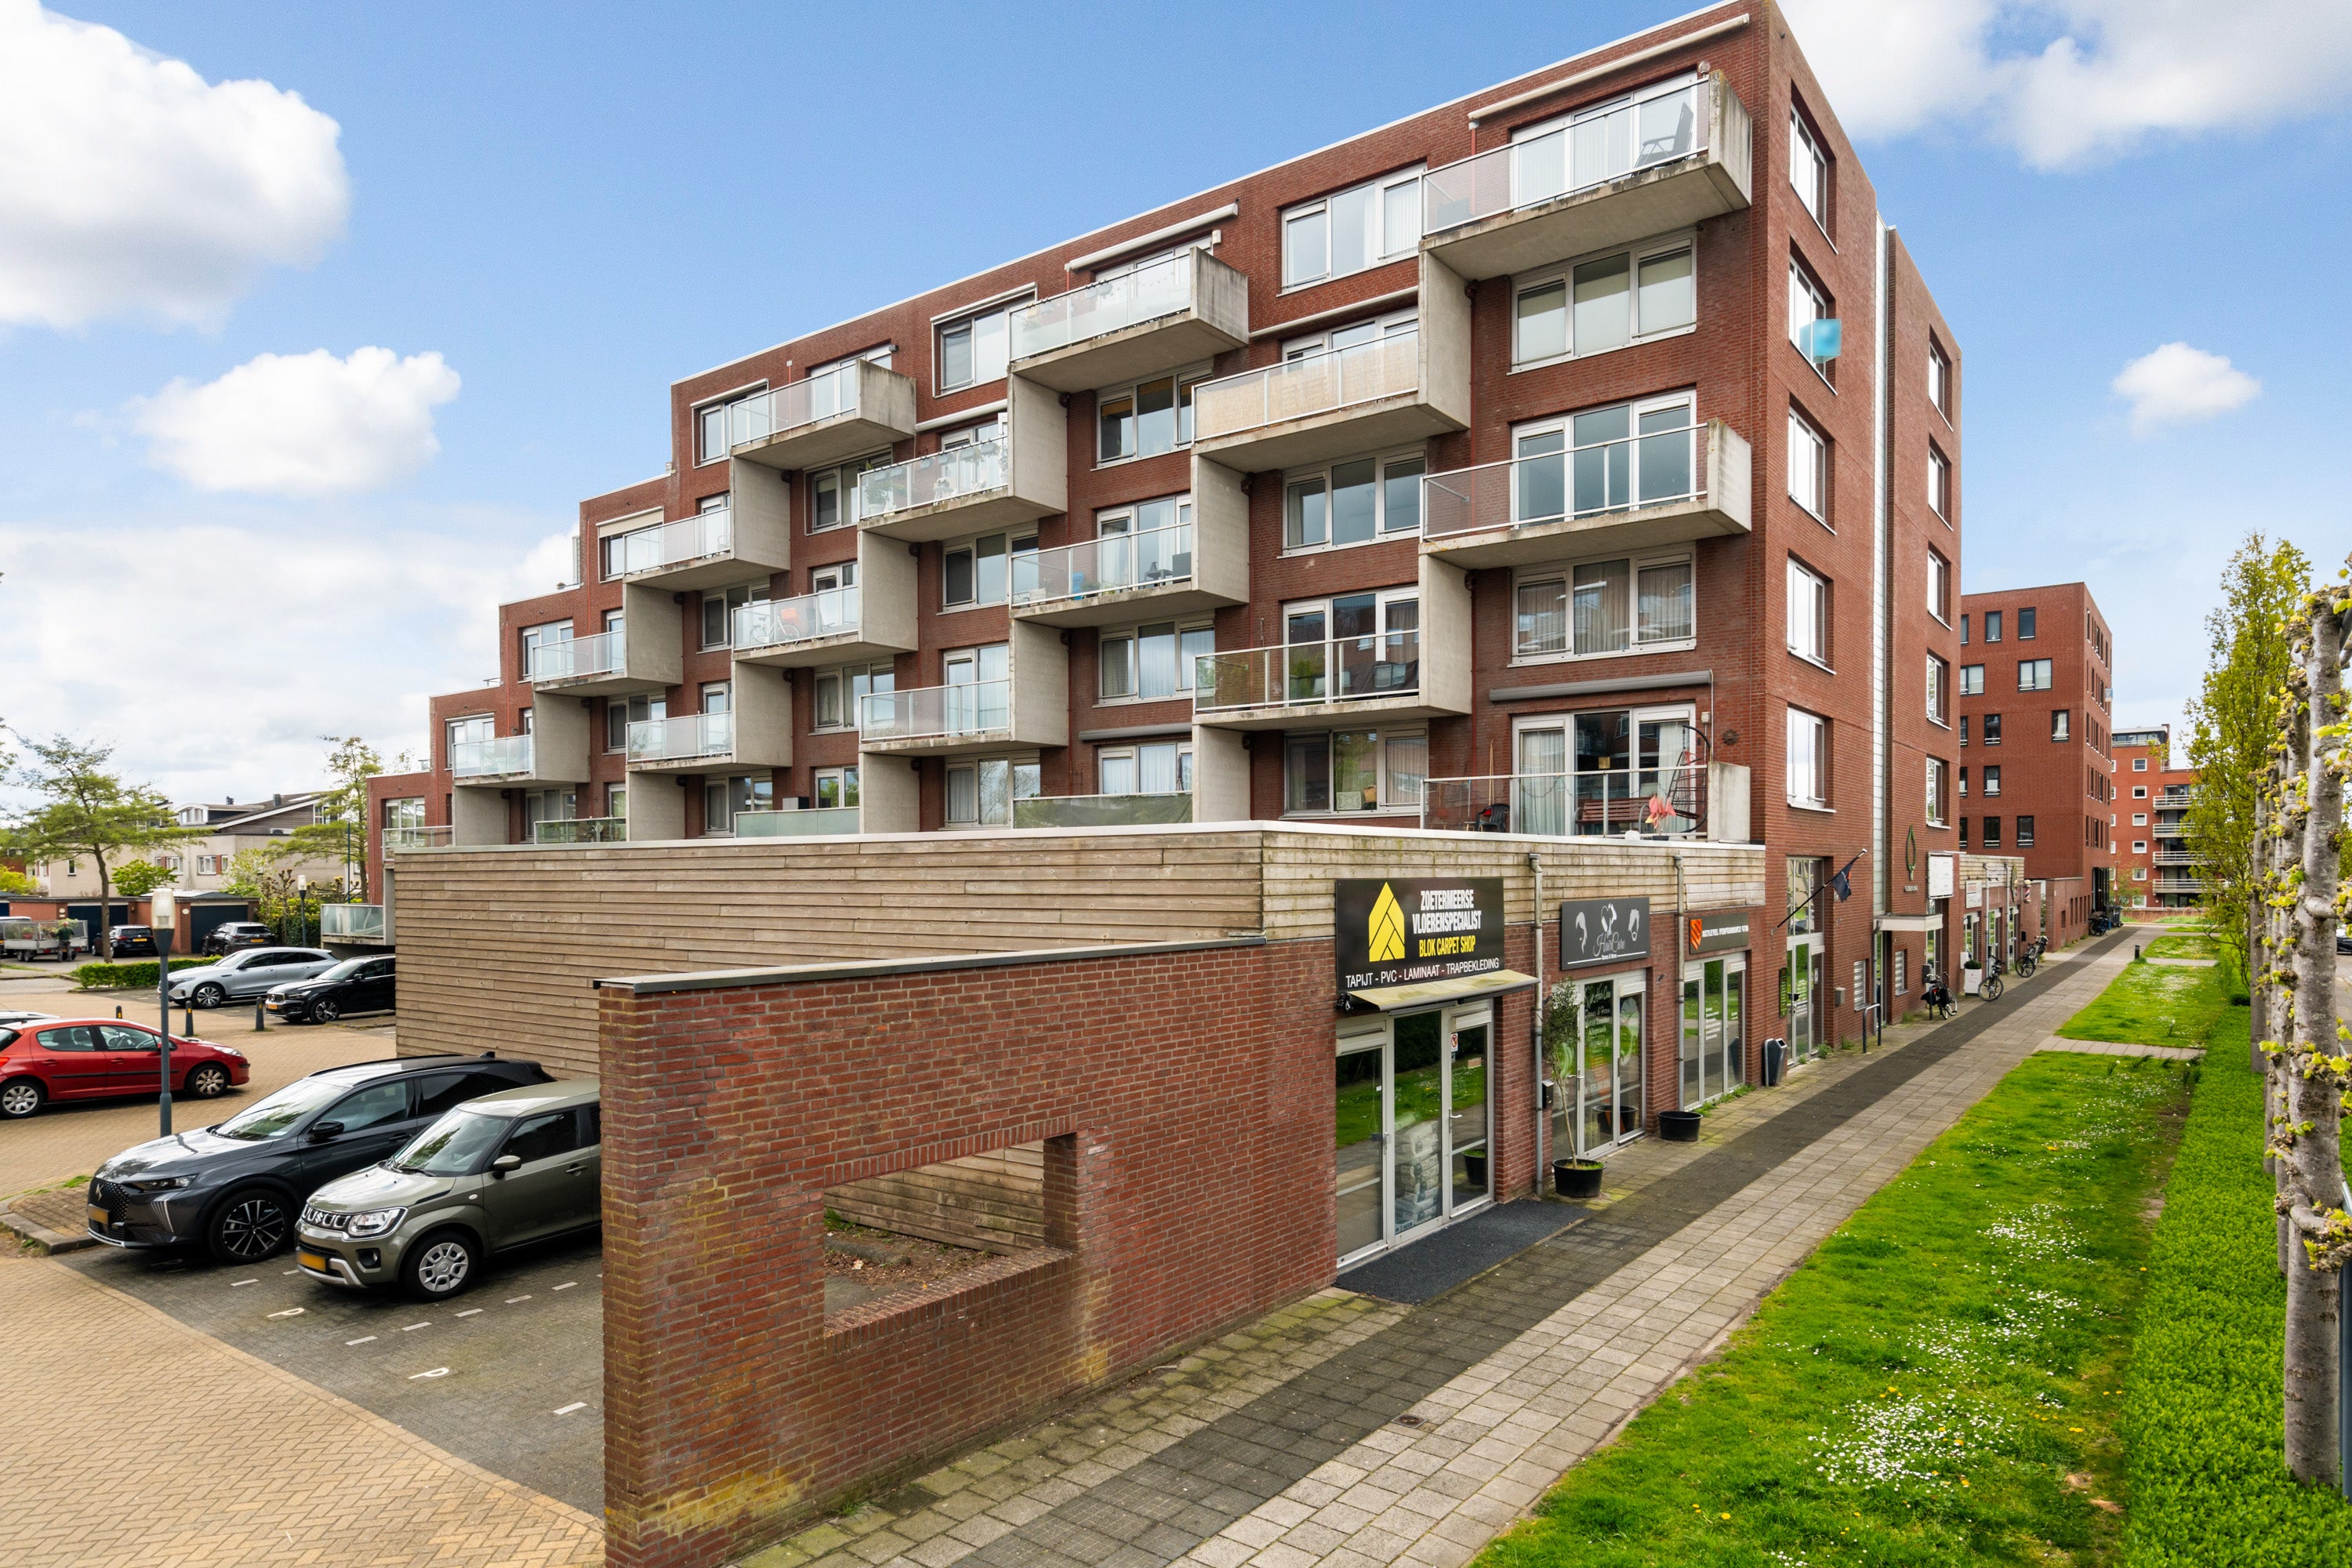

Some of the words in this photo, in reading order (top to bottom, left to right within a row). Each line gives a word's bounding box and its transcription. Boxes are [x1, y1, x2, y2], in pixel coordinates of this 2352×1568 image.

[1421, 889, 1474, 911] ZOETERMEERSE
[1412, 910, 1482, 934] VLOERENSPECIALIST
[1419, 938, 1436, 957] BLOK
[1436, 937, 1460, 956] CARPET
[1461, 935, 1475, 953] SHOP
[1345, 972, 1374, 988] TAPIJT
[1381, 969, 1397, 983] PVC
[1403, 964, 1440, 981] LAMINAAT
[1446, 957, 1499, 975] TRAPBEKLEDING
[267, 1307, 305, 1317] P
[408, 1367, 449, 1379] P
